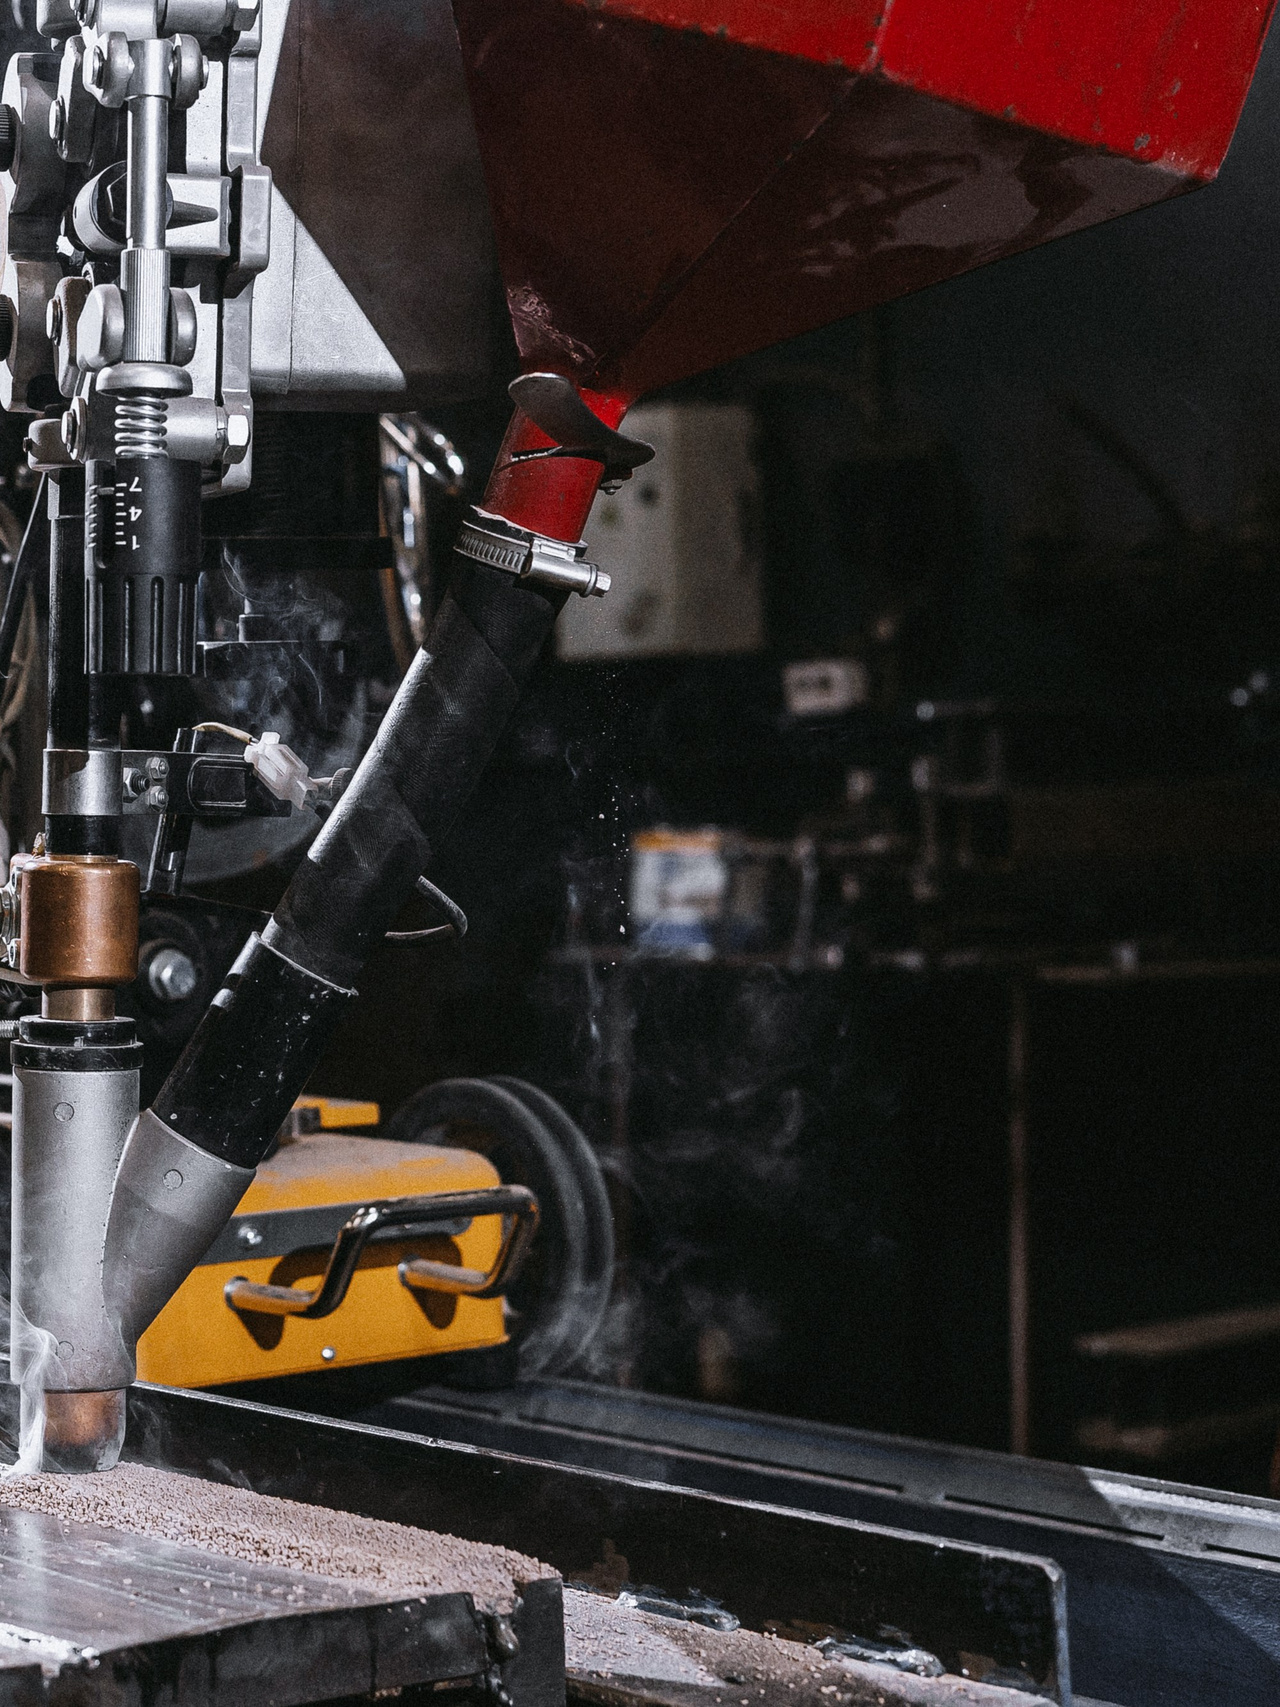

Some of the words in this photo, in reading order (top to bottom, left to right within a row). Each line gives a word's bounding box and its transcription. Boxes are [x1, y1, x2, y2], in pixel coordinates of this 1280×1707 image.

[128, 476, 143, 492] 7
[128, 506, 143, 521] 4
[131, 535, 140, 550] 1
